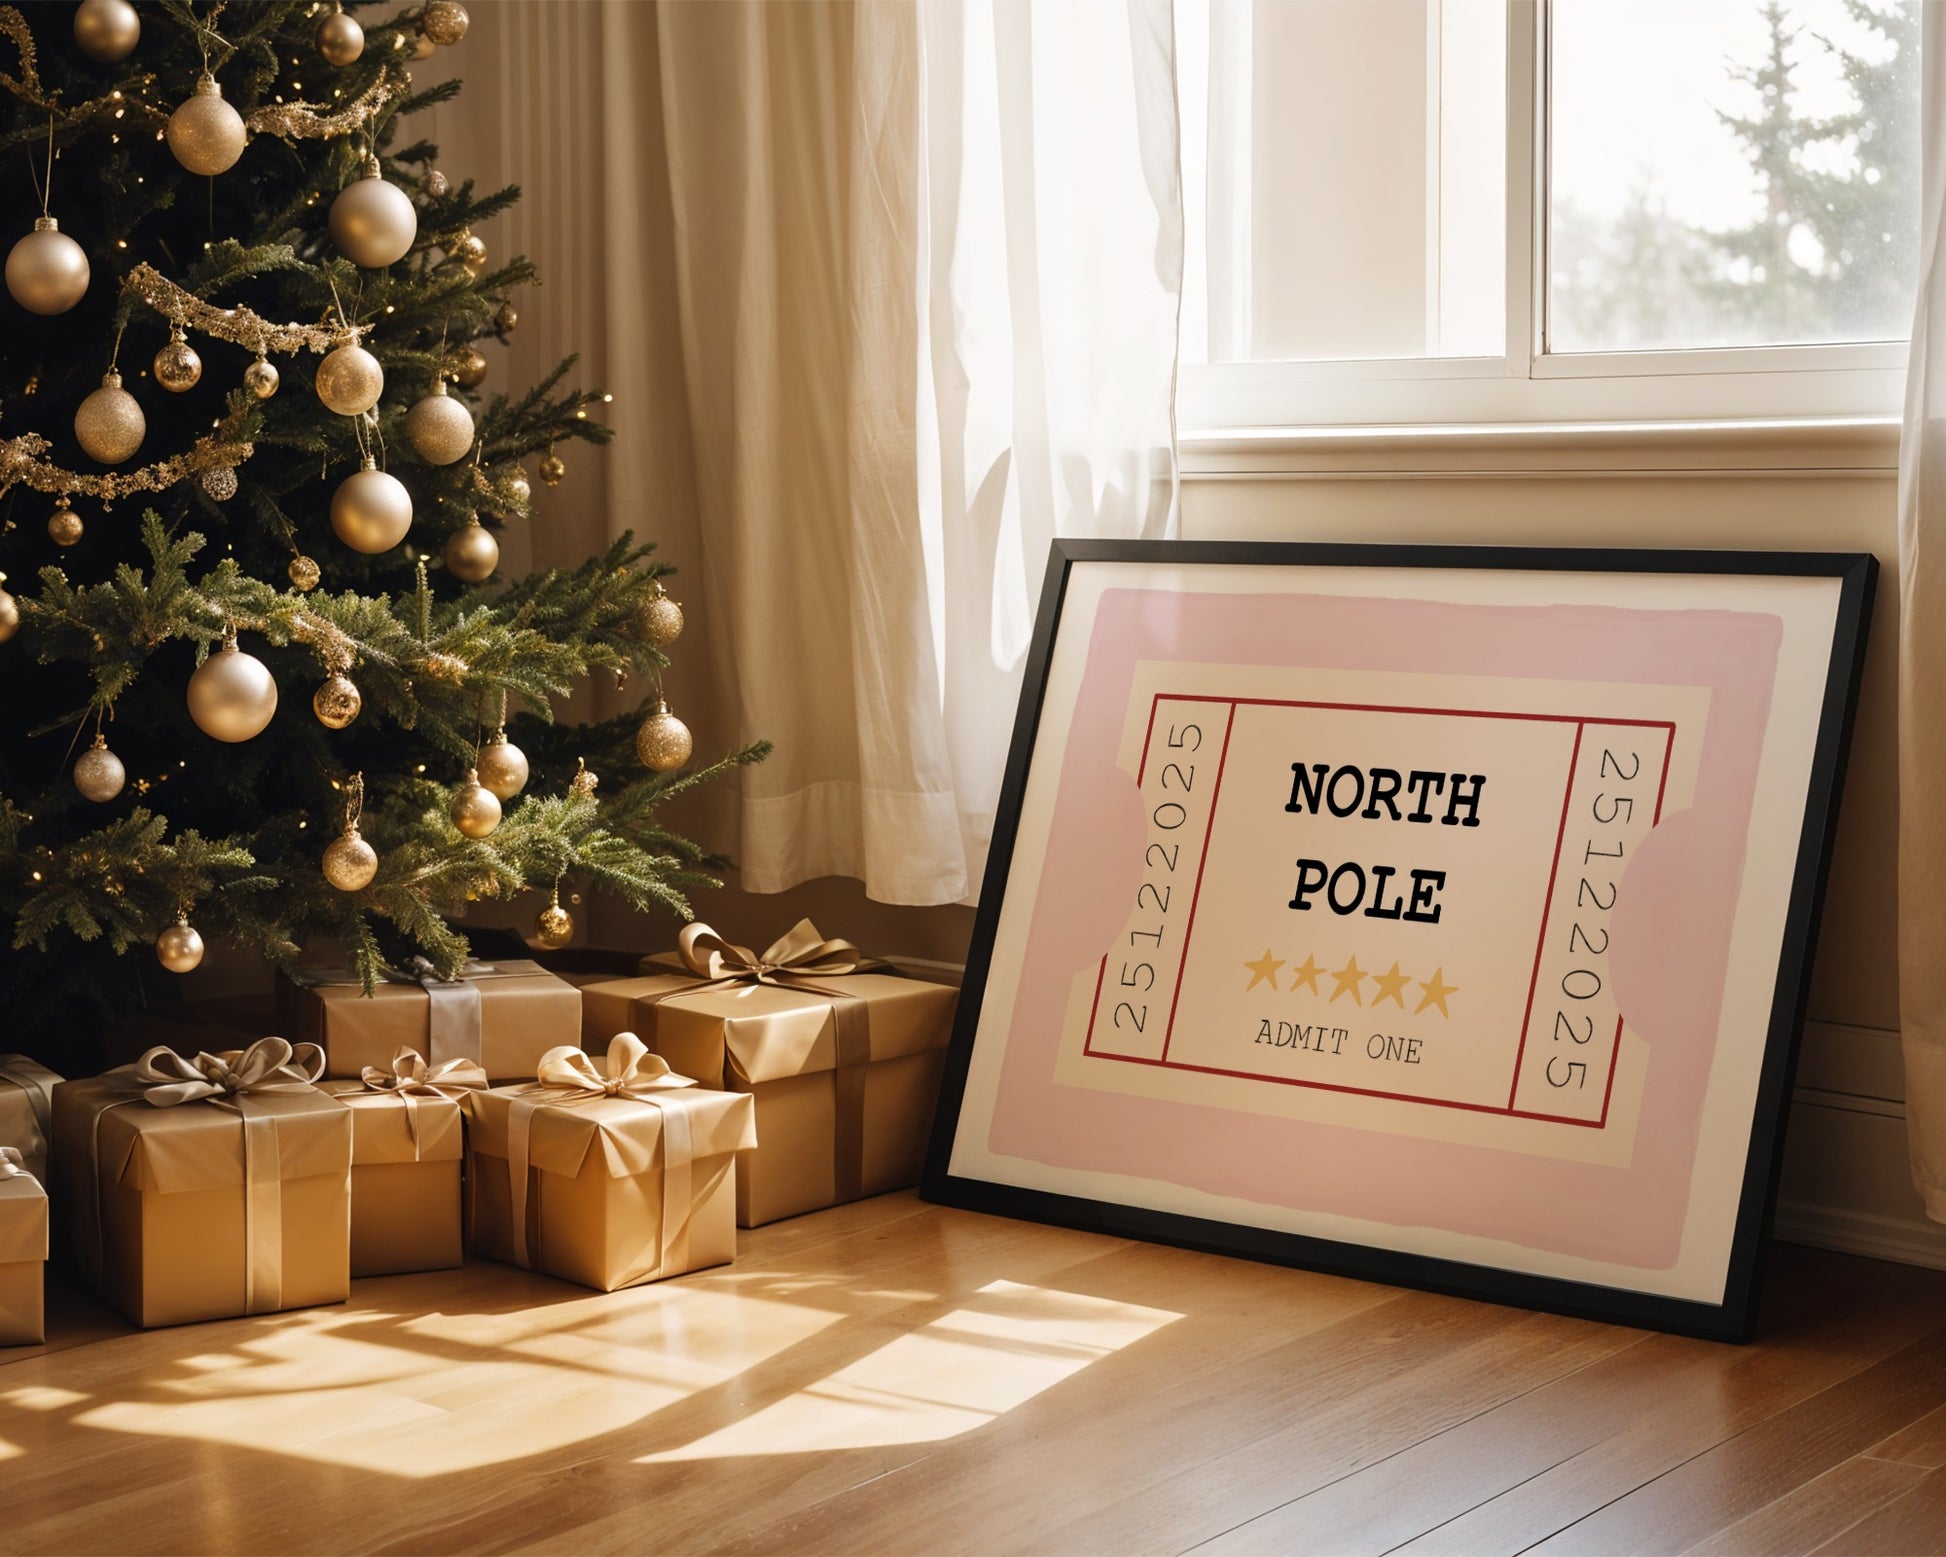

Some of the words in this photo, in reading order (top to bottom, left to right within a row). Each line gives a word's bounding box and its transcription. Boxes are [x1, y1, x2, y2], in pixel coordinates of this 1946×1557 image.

[1285, 762, 1487, 827] NORTH
[1113, 723, 1202, 1033] 25122025
[1288, 858, 1447, 924] POLE
[1545, 749, 1640, 1089] 25122025
[1254, 1019, 1349, 1055] ADMIT
[1366, 1034, 1423, 1064] ONE
